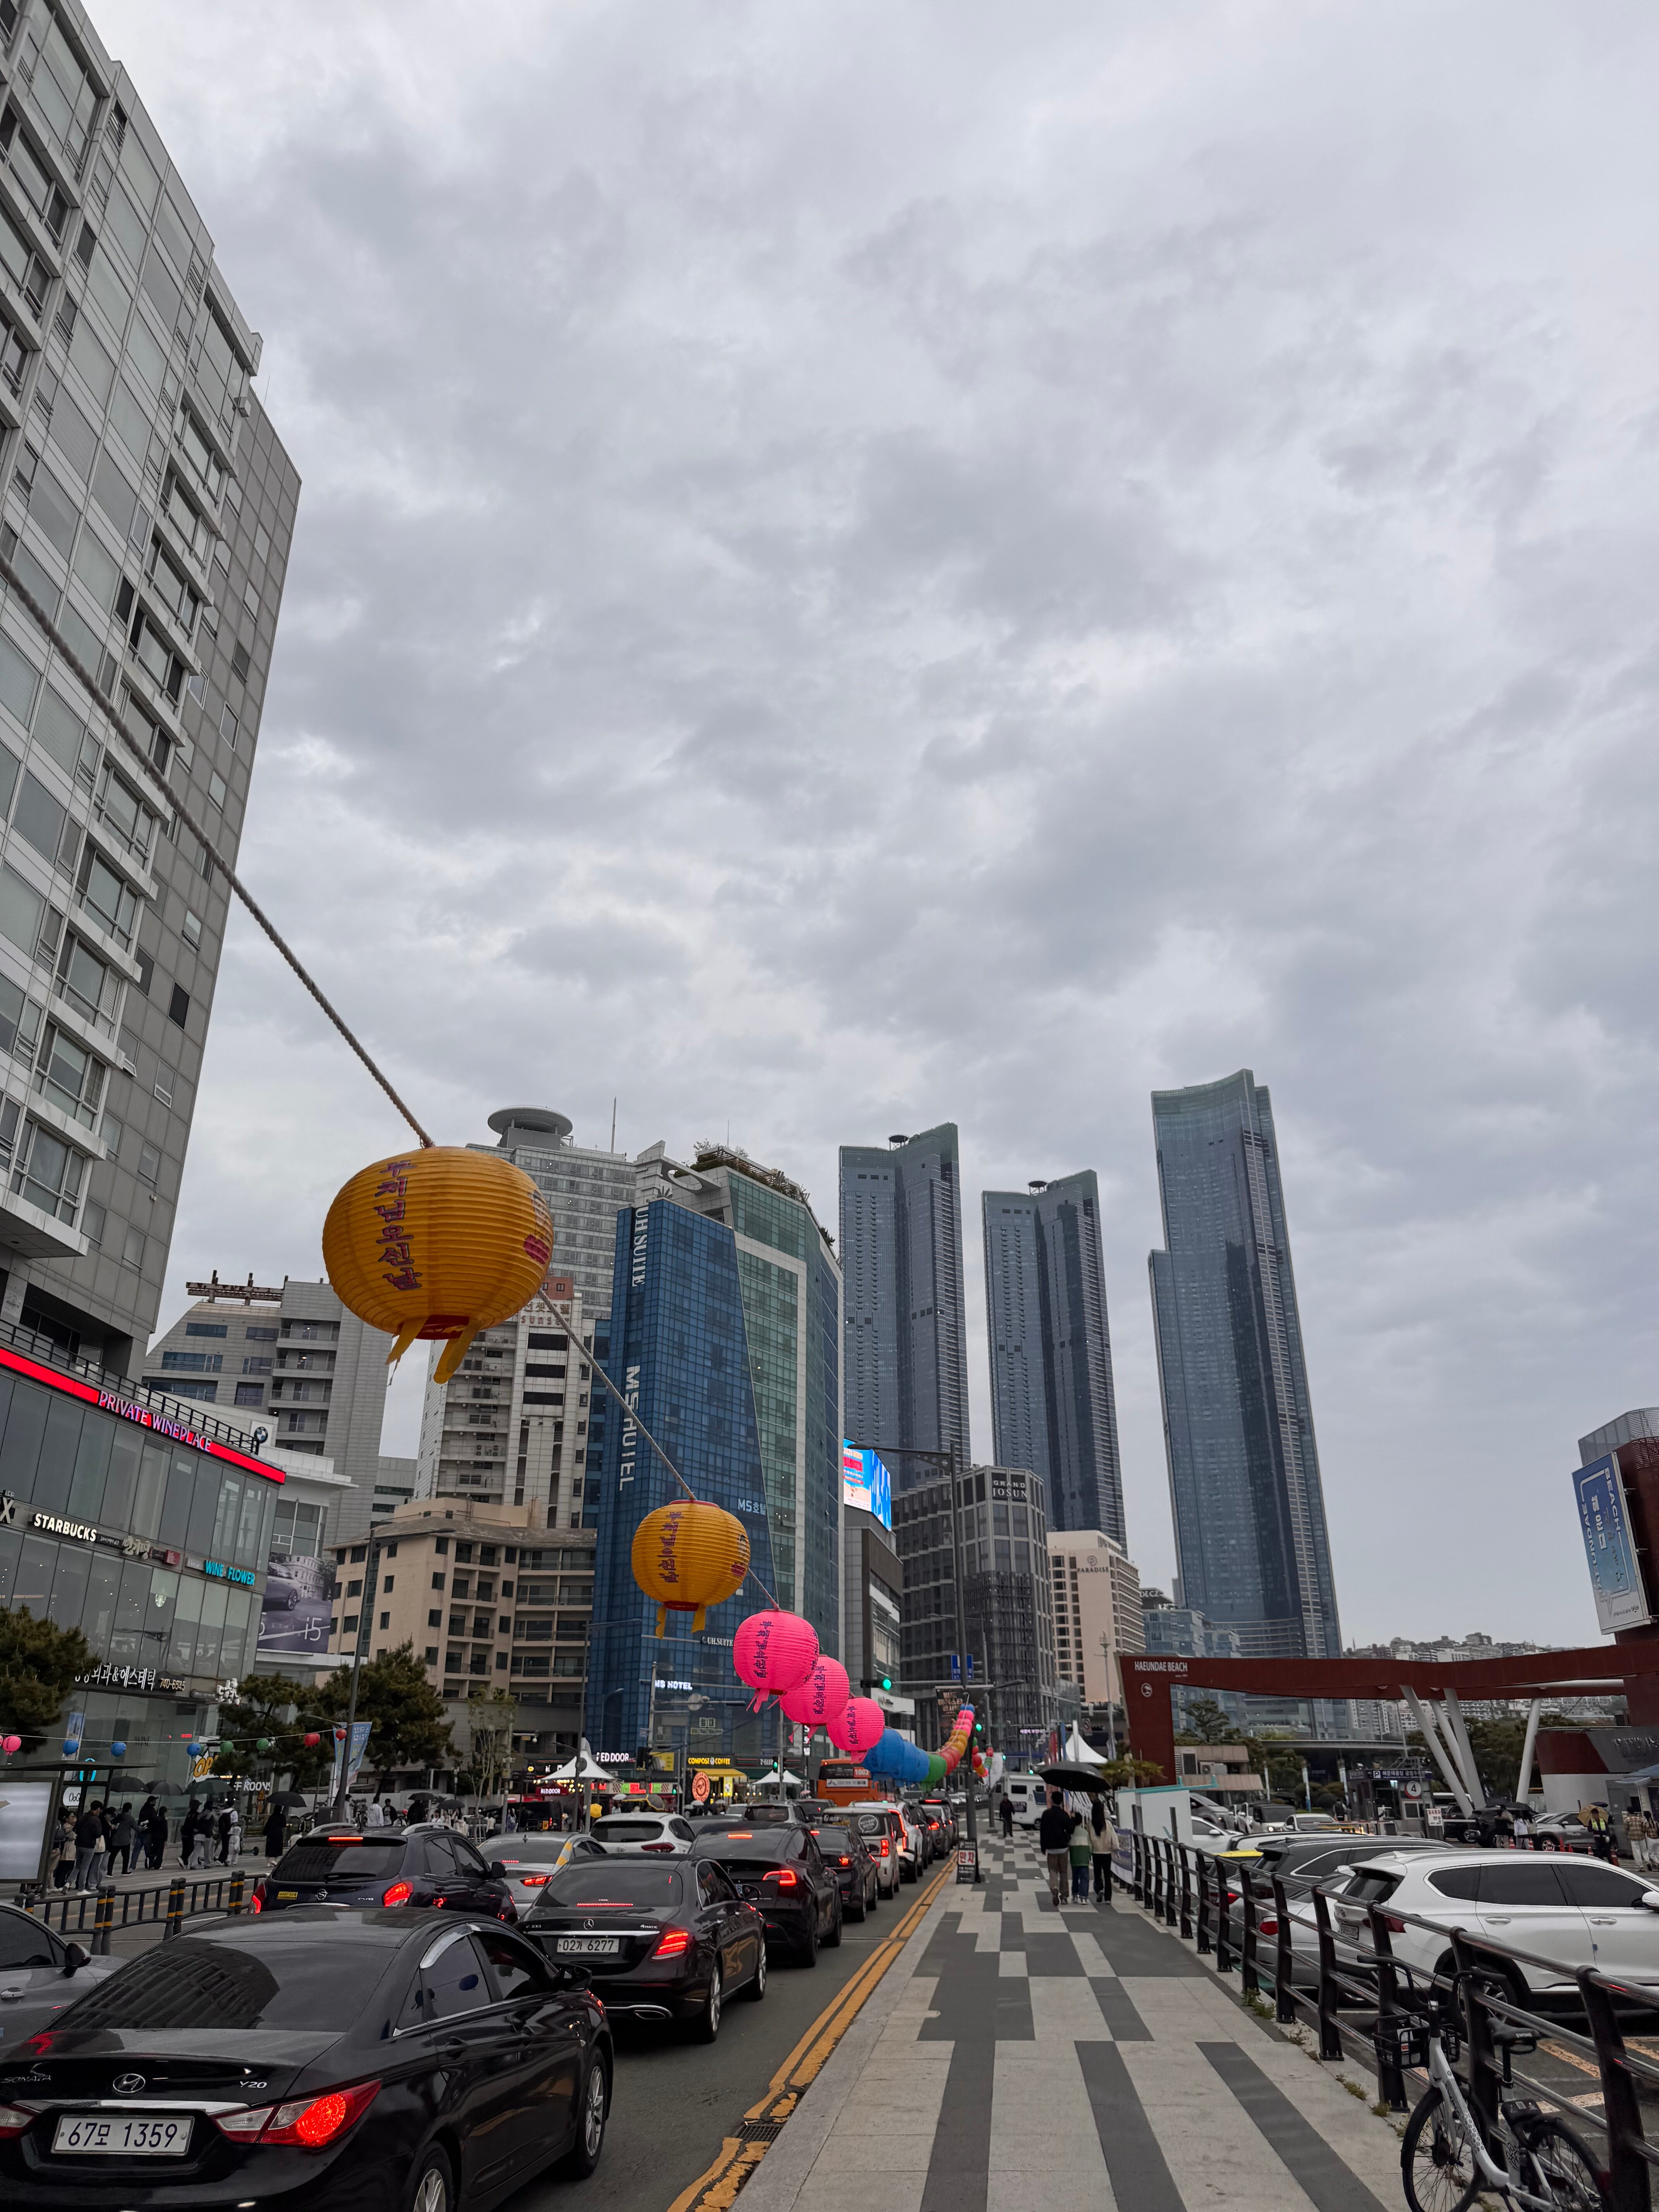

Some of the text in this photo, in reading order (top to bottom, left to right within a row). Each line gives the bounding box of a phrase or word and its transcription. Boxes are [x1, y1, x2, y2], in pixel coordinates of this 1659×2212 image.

[374, 1160, 422, 1291] 부처님오신날
[98, 1390, 212, 1453] PRIVATE WINEPLACE
[993, 1488, 1027, 1498] JOSUN
[34, 1513, 97, 1542] STARBUCKS
[205, 1559, 255, 1586] WINE FLOWER
[304, 1616, 322, 1641] i5
[75, 1662, 156, 1691] 외과&에스테틱
[1134, 1661, 1188, 1672] HAEUNDAE BEACH
[667, 1680, 693, 1691] HOTEL
[587, 1940, 614, 1951] 6277
[239, 2081, 267, 2089] Y20
[68, 2123, 178, 2148] 67모 1359
